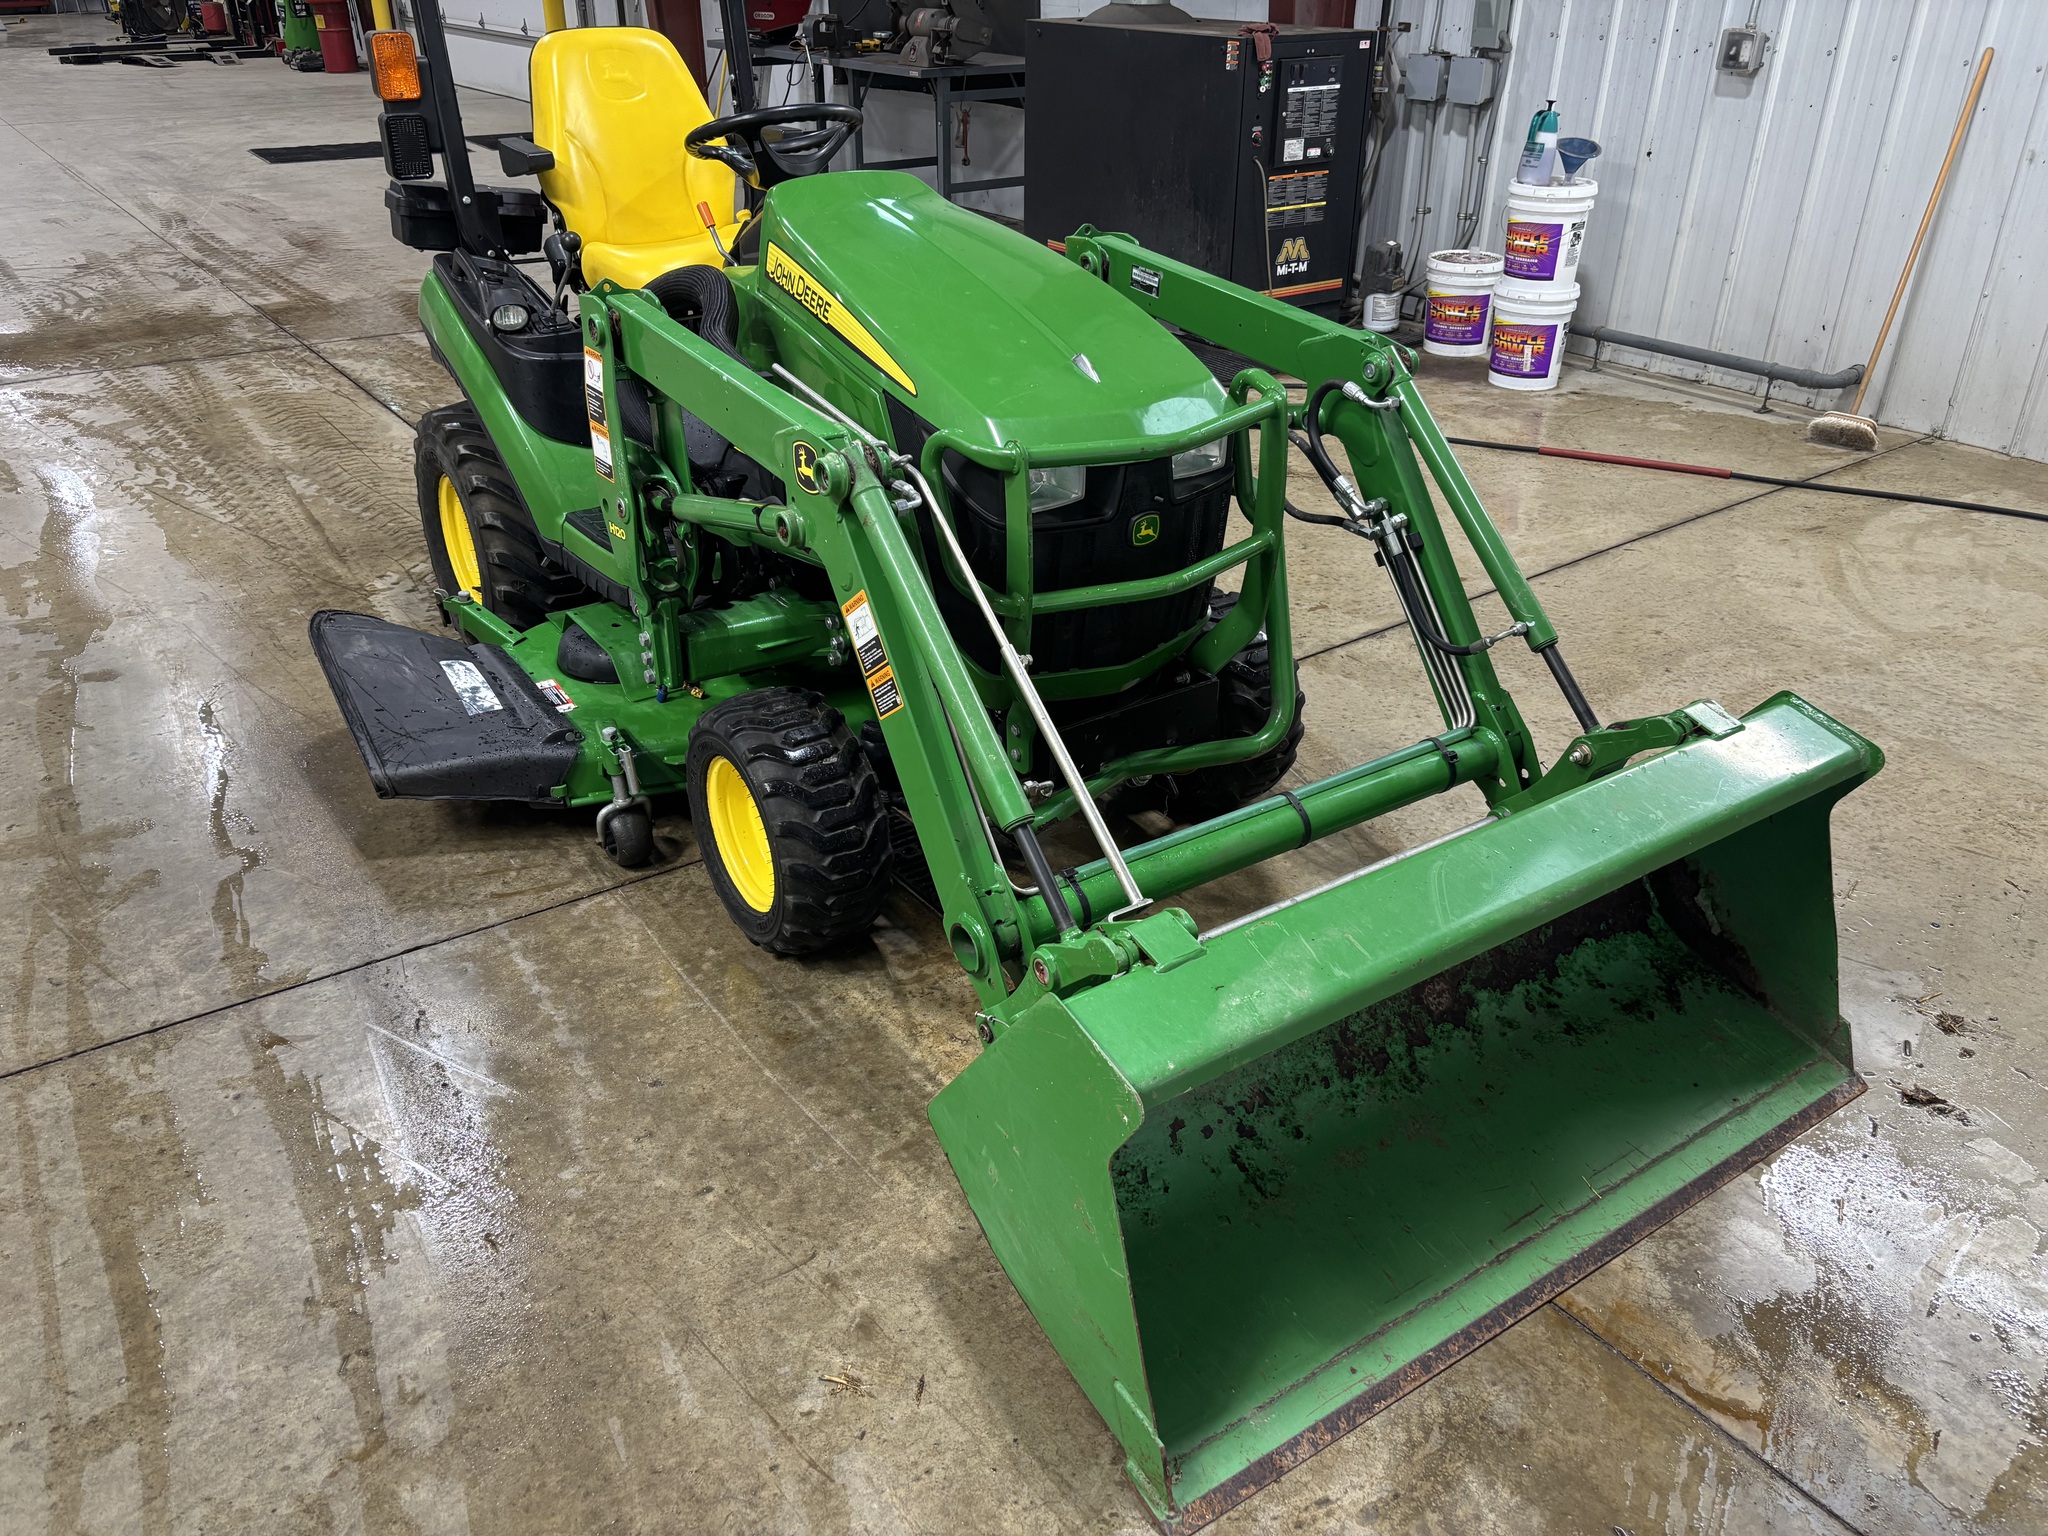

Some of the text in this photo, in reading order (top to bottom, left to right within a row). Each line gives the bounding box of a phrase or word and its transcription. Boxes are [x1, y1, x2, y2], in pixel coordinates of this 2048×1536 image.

[1507, 230, 1551, 244] URPLE
[1505, 240, 1549, 256] OWER
[1276, 261, 1308, 276] Mi-T-M
[770, 256, 832, 321] JOHN DEERE
[1430, 300, 1482, 313] PURPLE
[1429, 309, 1481, 323] POWER
[1494, 328, 1547, 344] PURPLE
[1493, 338, 1546, 356] POWR
[849, 594, 865, 611] WARNING
[874, 669, 891, 686] WARNING
